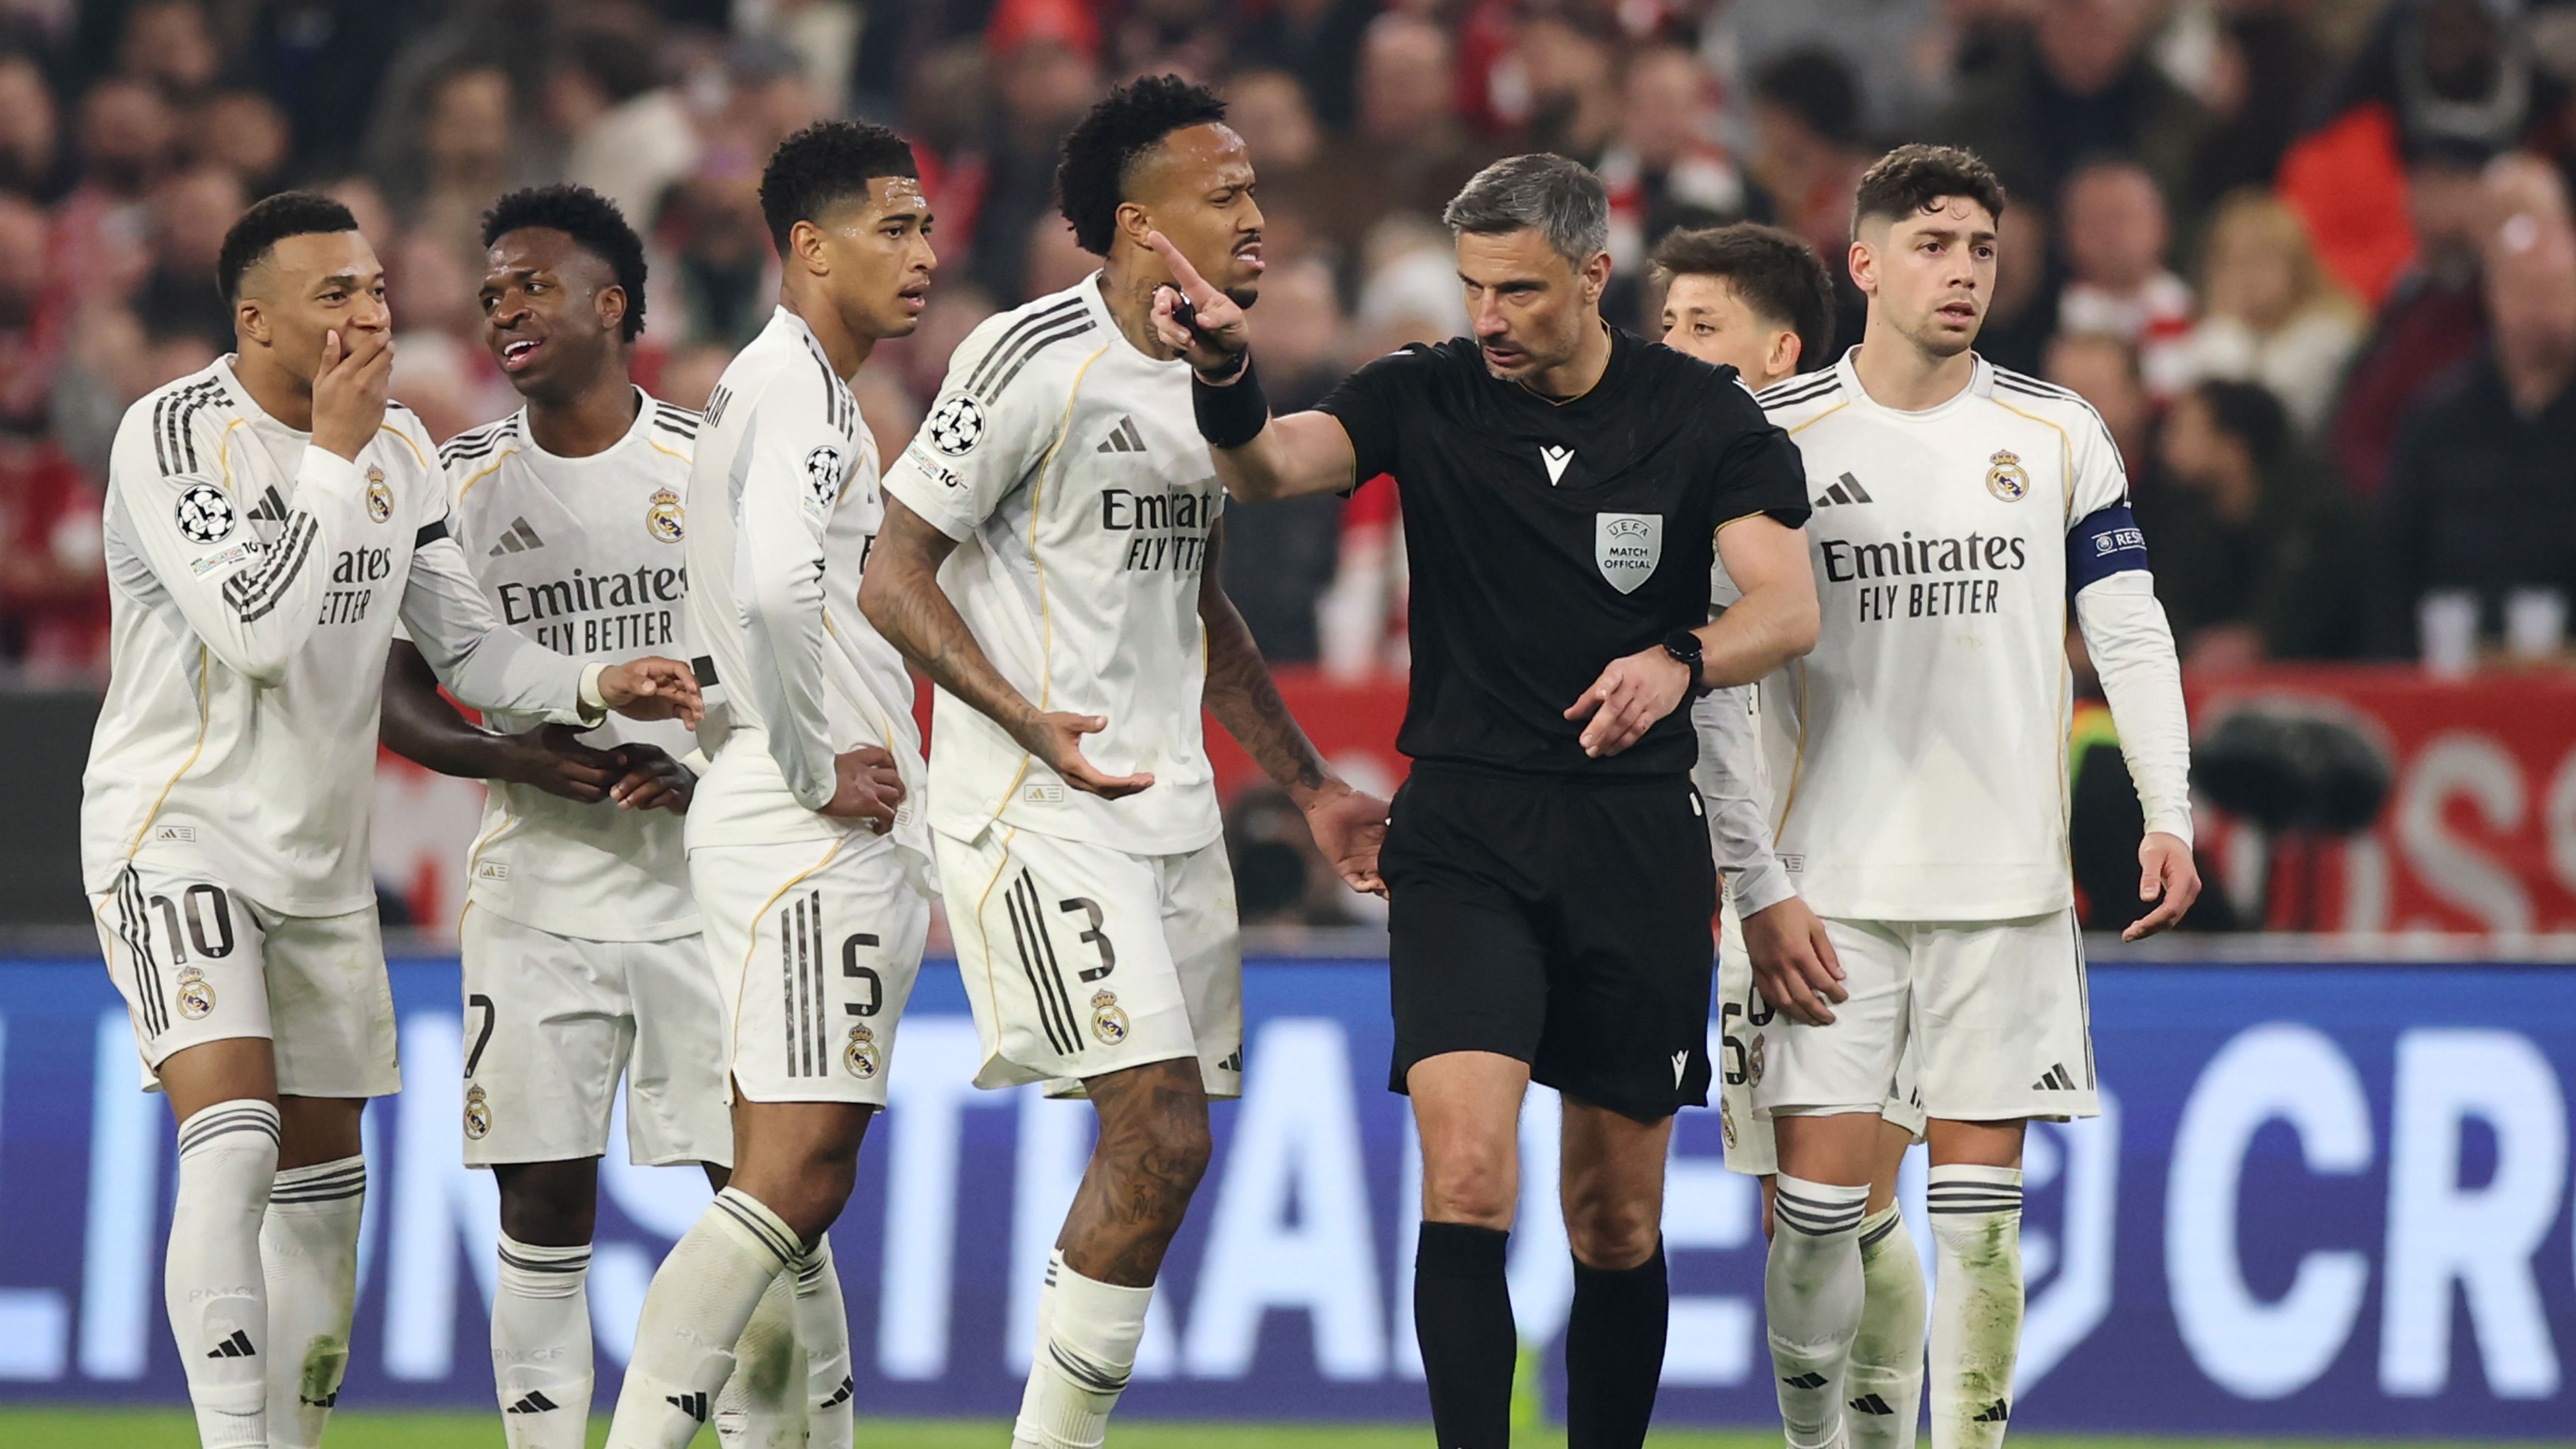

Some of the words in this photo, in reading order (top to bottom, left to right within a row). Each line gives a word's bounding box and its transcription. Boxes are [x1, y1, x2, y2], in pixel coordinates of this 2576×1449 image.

[1609, 522, 1648, 536] UEFA
[333, 544, 391, 583] ates
[1127, 538, 1166, 570] FLY
[1604, 560, 1651, 569] OFFICIAL
[1609, 547, 1647, 556] MATCH
[1821, 531, 2026, 582] Emirates
[318, 589, 371, 625] ETTER
[1860, 586, 1898, 622] FLY
[1909, 580, 1999, 618] BETTER
[585, 611, 673, 653] BETTER
[151, 883, 234, 965] 10
[1059, 896, 1116, 983] 3
[842, 933, 882, 1016] 5
[464, 994, 495, 1079] 7
[2163, 1021, 2576, 1400] CR
